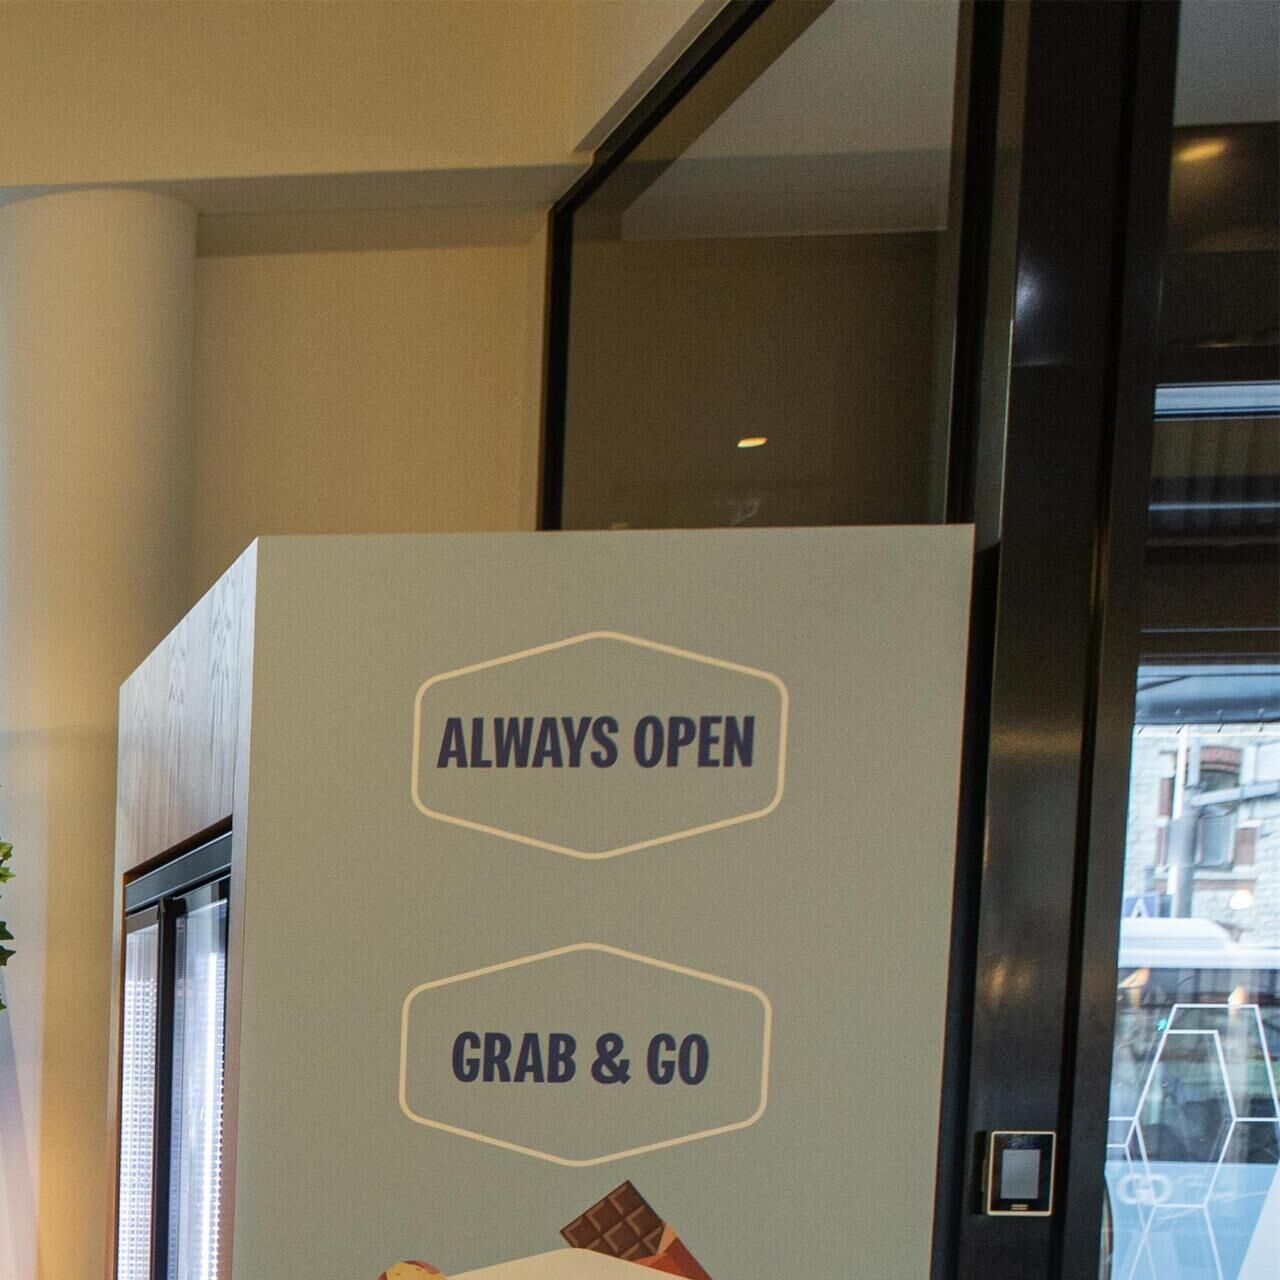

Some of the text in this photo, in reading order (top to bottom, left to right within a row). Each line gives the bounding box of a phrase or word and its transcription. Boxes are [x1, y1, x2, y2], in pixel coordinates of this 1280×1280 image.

[437, 715, 755, 769] ALWAYS OPEN
[451, 1031, 709, 1085] GRAB & GO
